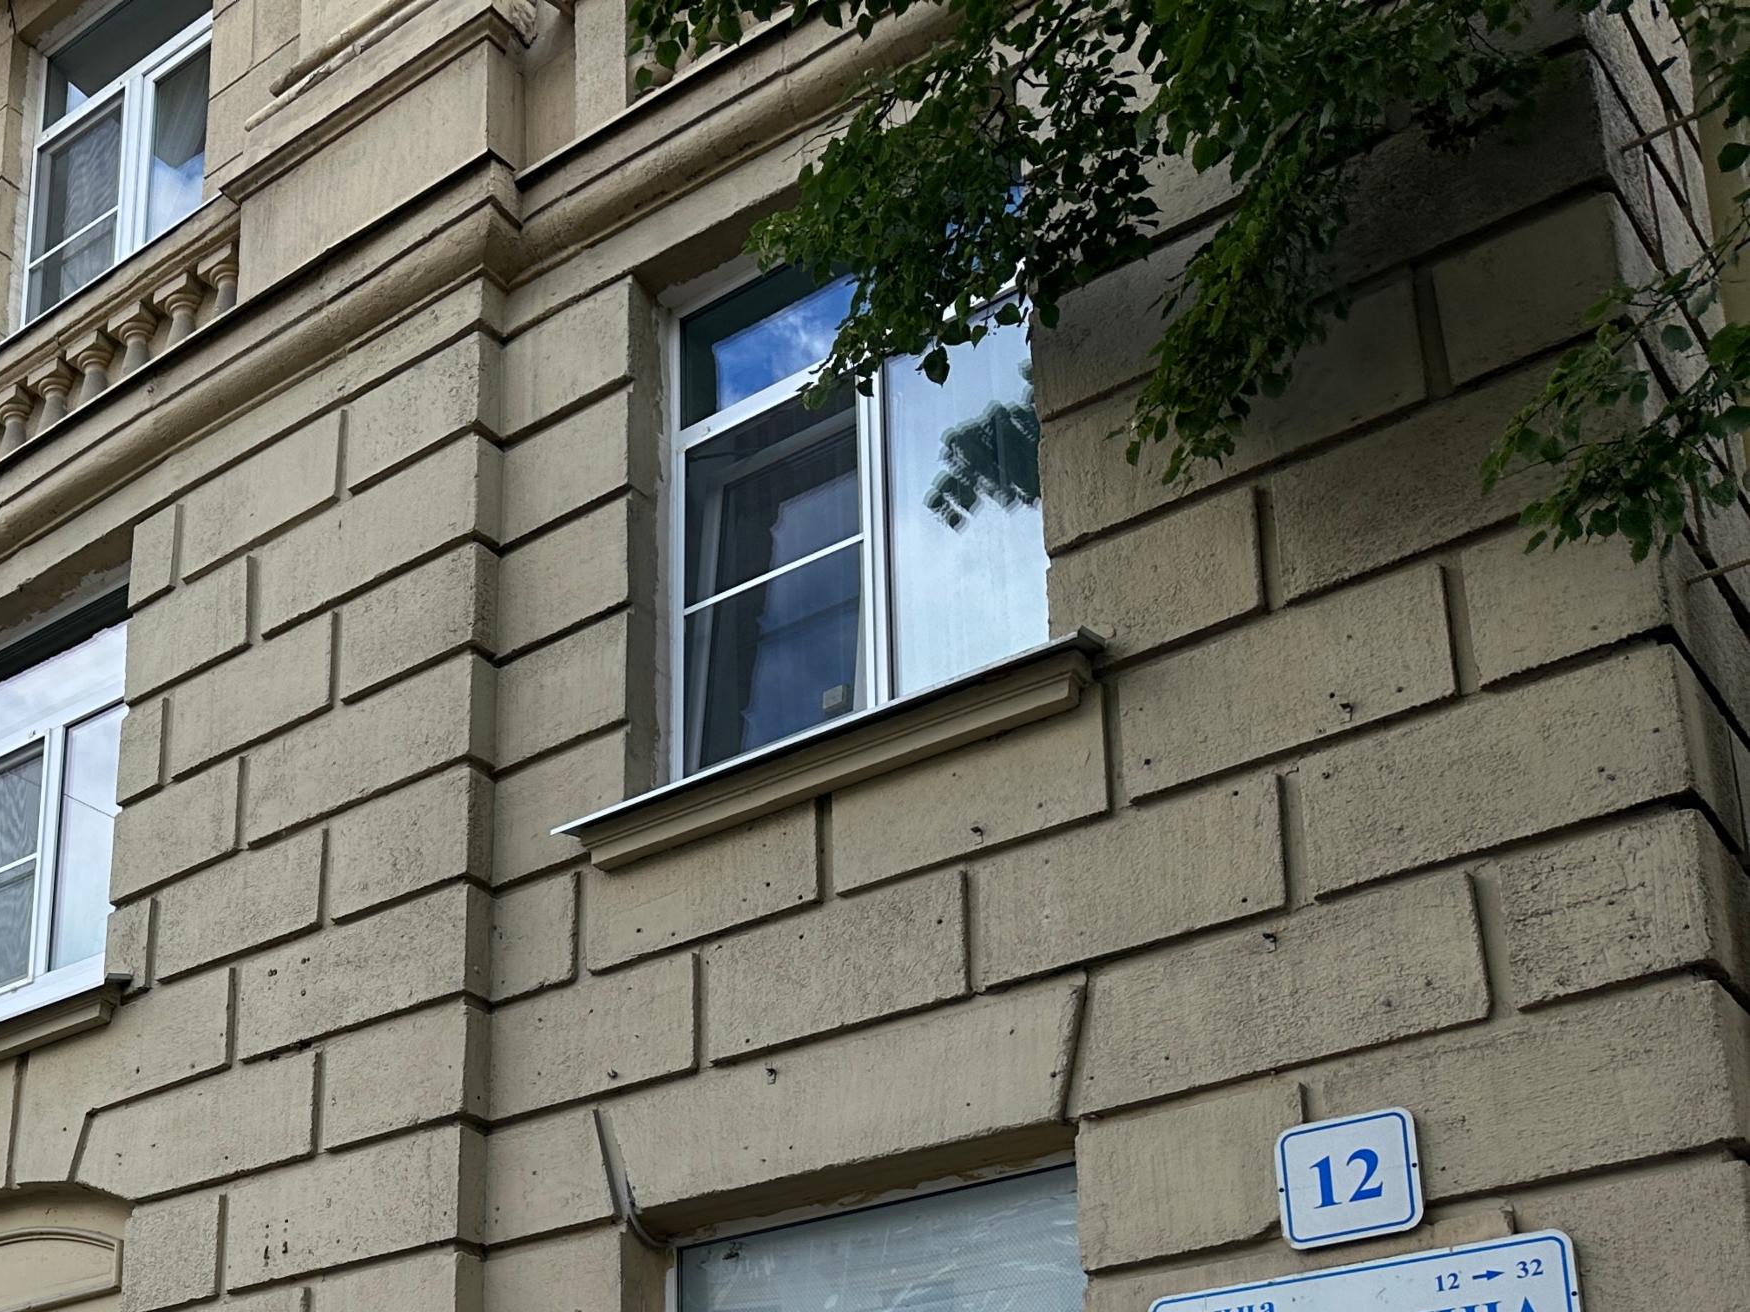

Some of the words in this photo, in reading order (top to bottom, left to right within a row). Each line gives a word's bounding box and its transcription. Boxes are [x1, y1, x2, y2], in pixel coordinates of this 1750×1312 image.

[1309, 1147, 1384, 1210] 12
[1434, 1272, 1460, 1293] 12
[1515, 1258, 1544, 1279] 32
